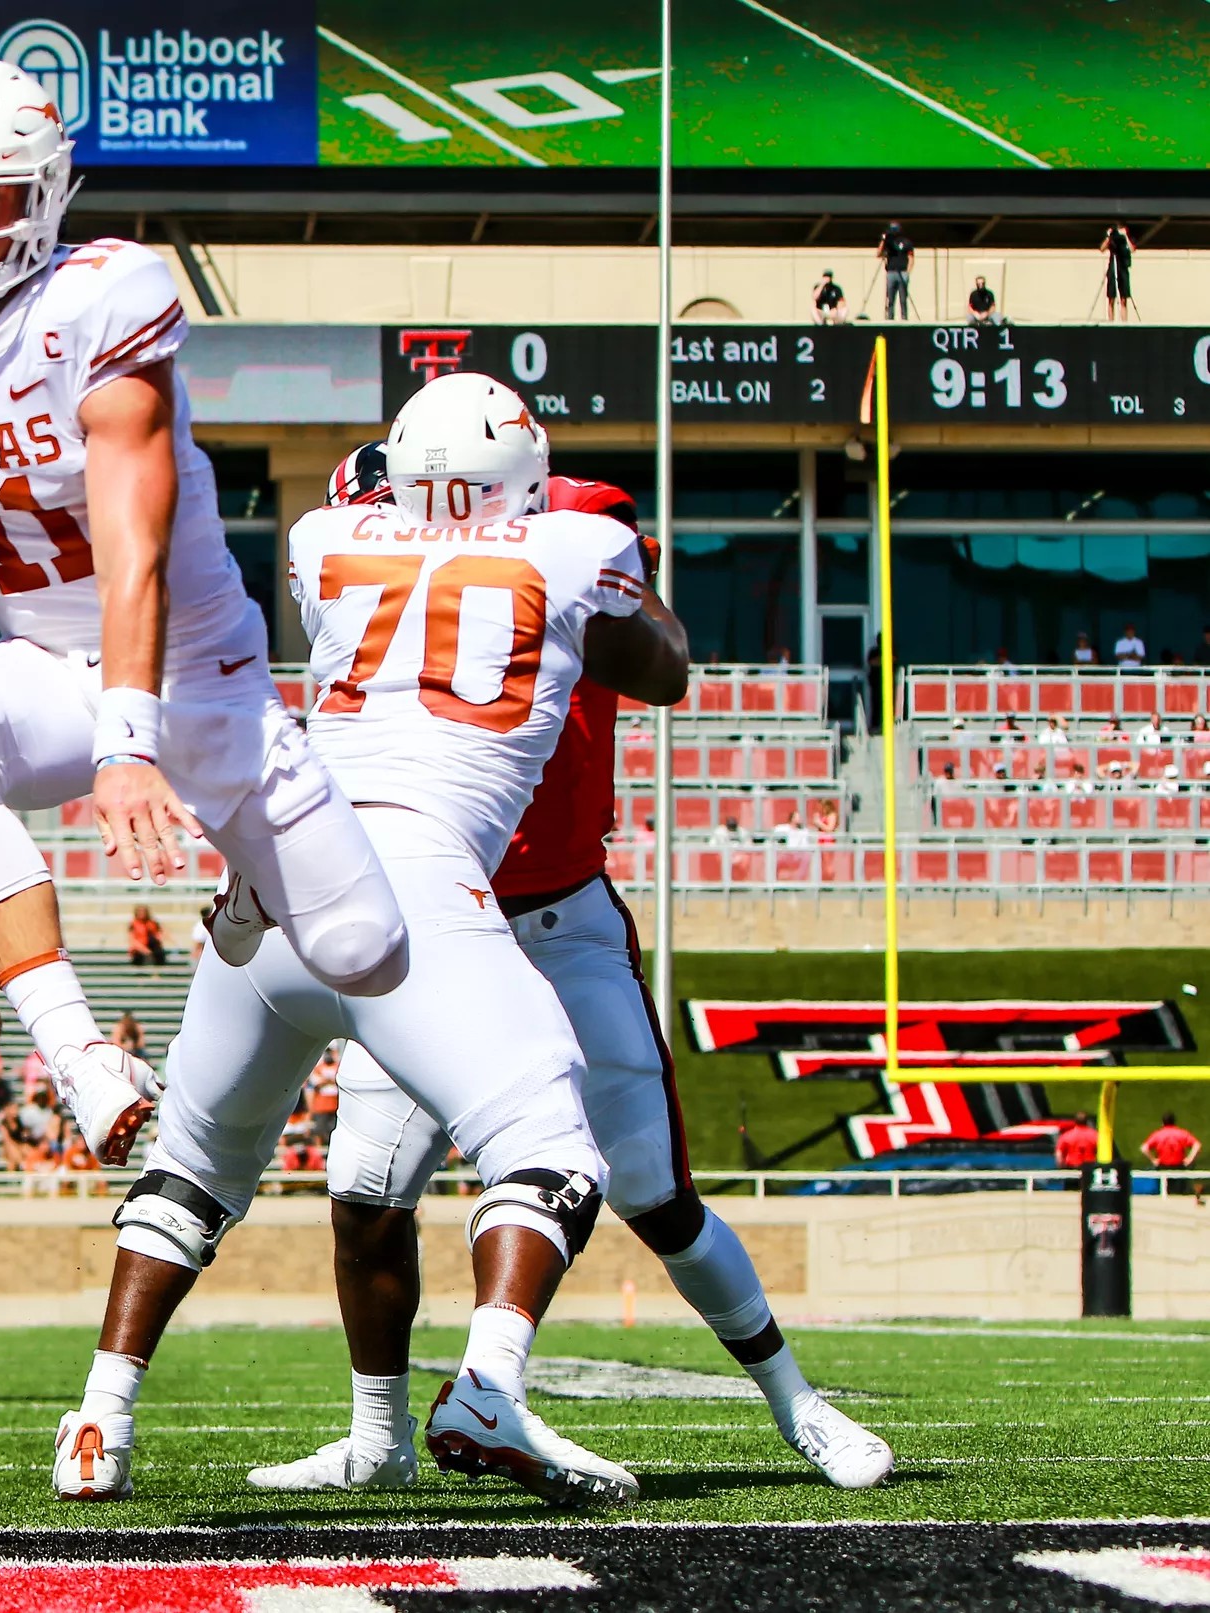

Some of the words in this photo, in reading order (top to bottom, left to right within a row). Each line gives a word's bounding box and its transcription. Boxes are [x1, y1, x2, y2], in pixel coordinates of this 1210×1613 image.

[100, 29, 284, 66] Lubbock
[100, 65, 274, 101] National
[100, 100, 209, 137] Bank
[43, 332, 63, 359] C
[671, 336, 714, 362] 1st
[723, 335, 778, 362] and
[796, 337, 815, 363] 2
[932, 328, 979, 352] QTR
[998, 329, 1014, 349] 1
[512, 332, 548, 383] 0
[672, 380, 731, 403] BALL
[736, 381, 771, 403] ON
[810, 379, 826, 401] 2
[930, 358, 1068, 409] 9:13
[535, 394, 570, 414] TOL
[1110, 395, 1144, 414] TOL
[425, 463, 447, 473] UNITY
[414, 478, 471, 521] 70
[319, 554, 546, 734] 70
